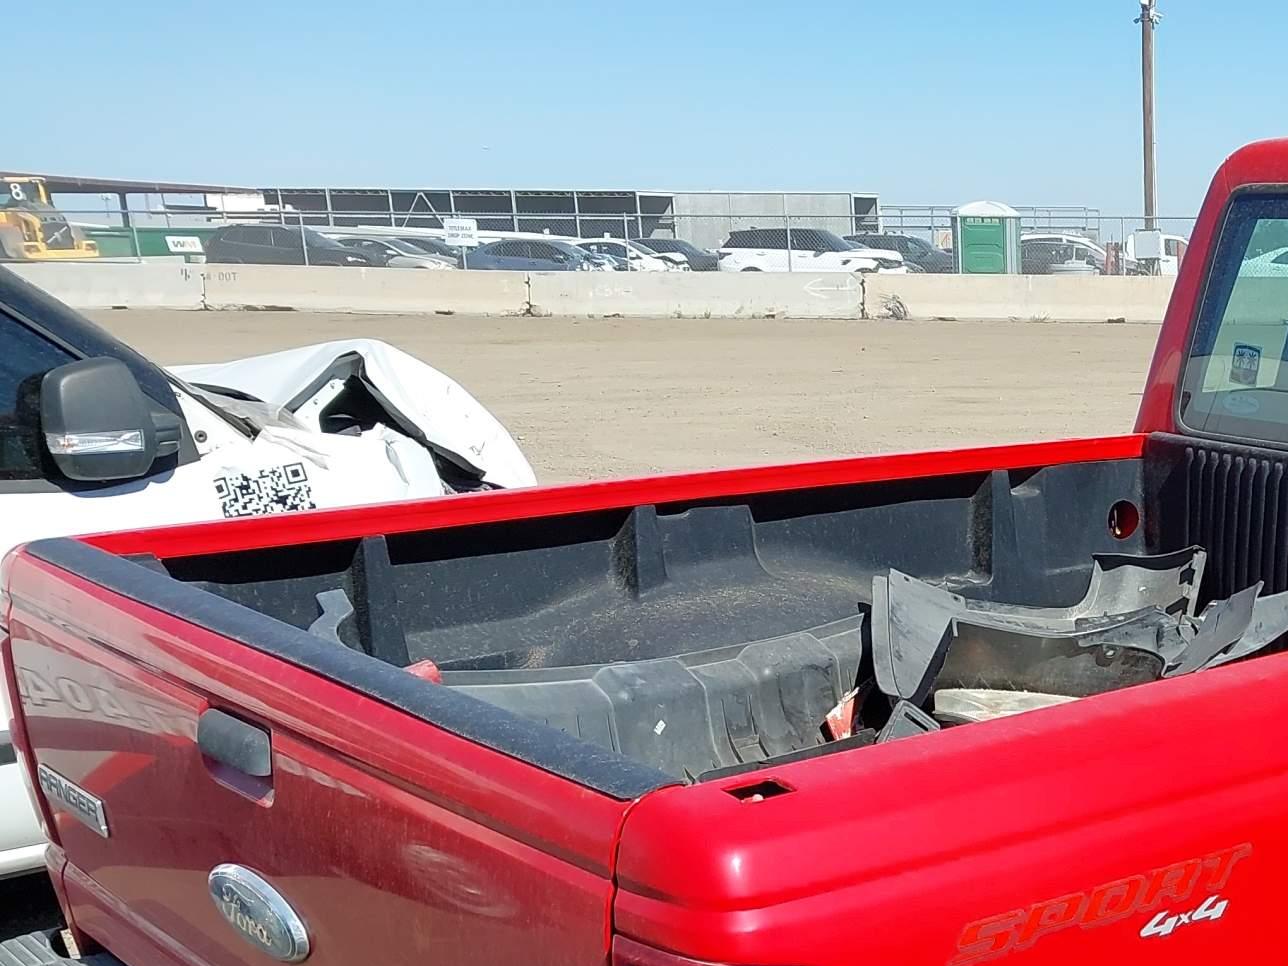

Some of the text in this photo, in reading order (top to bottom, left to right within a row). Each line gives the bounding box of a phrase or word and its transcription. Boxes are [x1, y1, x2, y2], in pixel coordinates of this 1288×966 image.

[10, 183, 24, 201] 8
[39, 767, 98, 822] RANGER
[1139, 895, 1230, 939] 4x4
